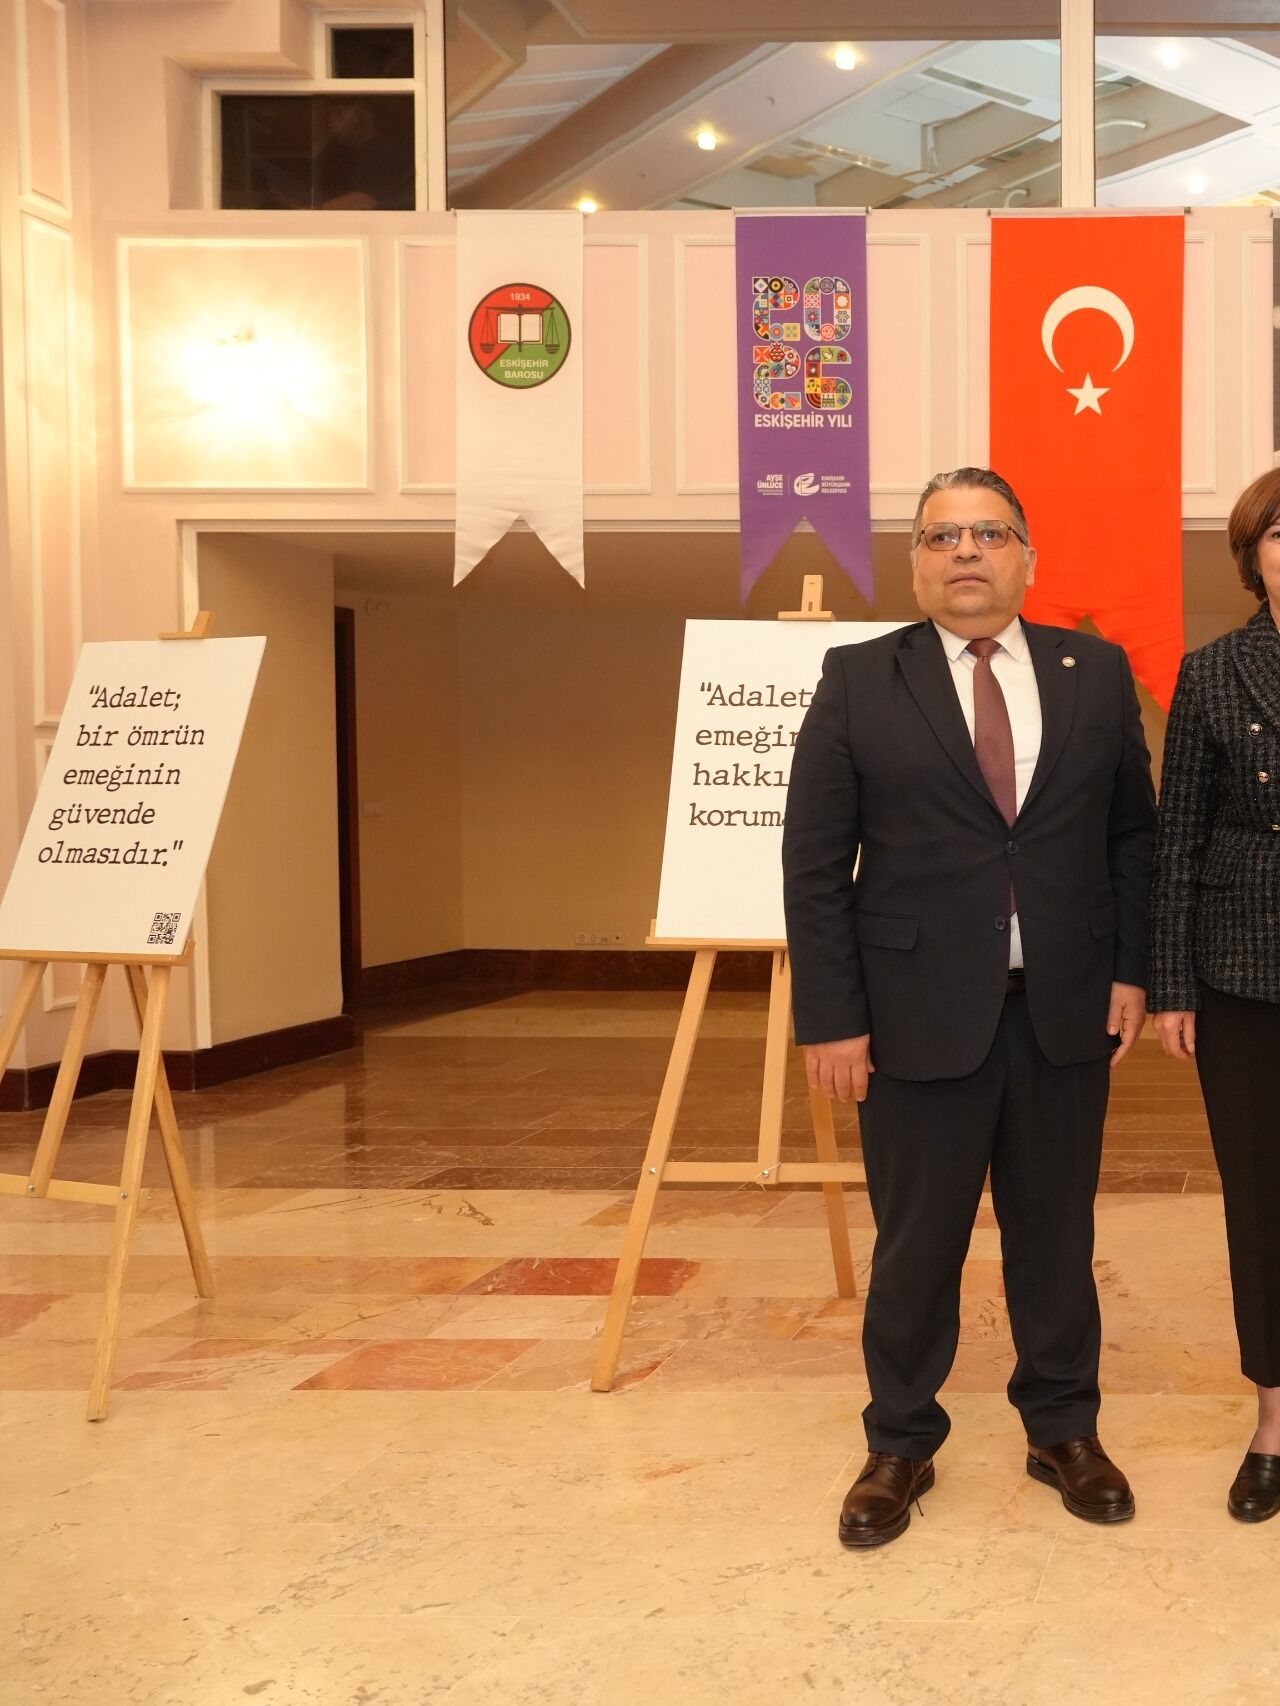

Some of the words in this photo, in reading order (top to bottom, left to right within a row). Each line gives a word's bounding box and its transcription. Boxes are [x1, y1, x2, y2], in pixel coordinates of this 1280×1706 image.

[510, 292, 531, 301] 1934
[500, 357, 549, 369] ESKİŞEHİR
[504, 370, 544, 379] BAROSU
[755, 411, 824, 429] ESKİŞEHİR
[828, 413, 852, 428] YILI
[90, 685, 181, 711] "Adalet;
[77, 725, 118, 746] bir
[127, 725, 205, 746] ömrün
[63, 763, 181, 792] emeğinin
[48, 802, 155, 831] güvende
[689, 803, 785, 826] korum
[38, 840, 183, 867] olmasıdır."
